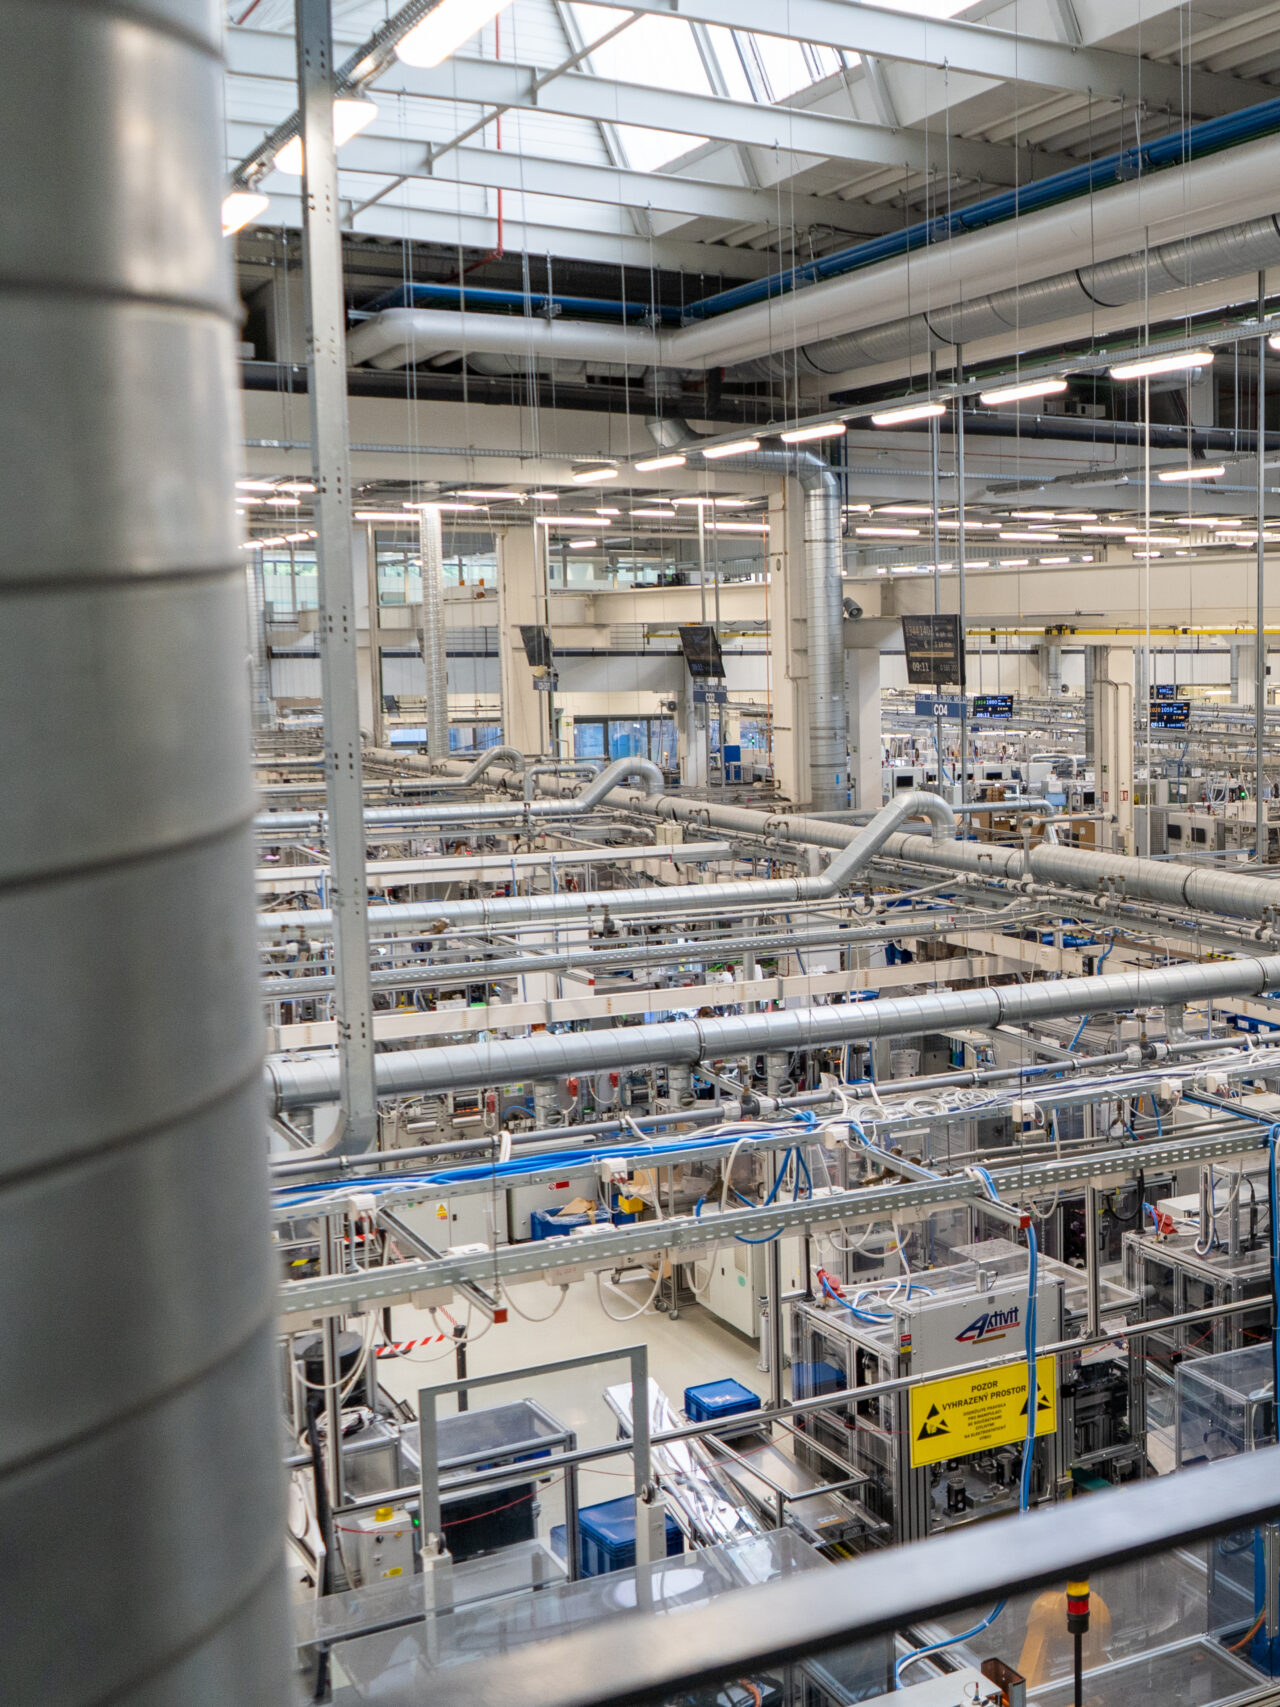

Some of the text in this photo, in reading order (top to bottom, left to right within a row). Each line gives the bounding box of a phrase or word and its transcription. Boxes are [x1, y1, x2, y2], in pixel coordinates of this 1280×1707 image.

[955, 1306, 1020, 1340] Aktivit
[942, 1385, 1027, 1411] VYHRAZENÝ PROSTOR
[971, 1380, 998, 1393] POZOR
